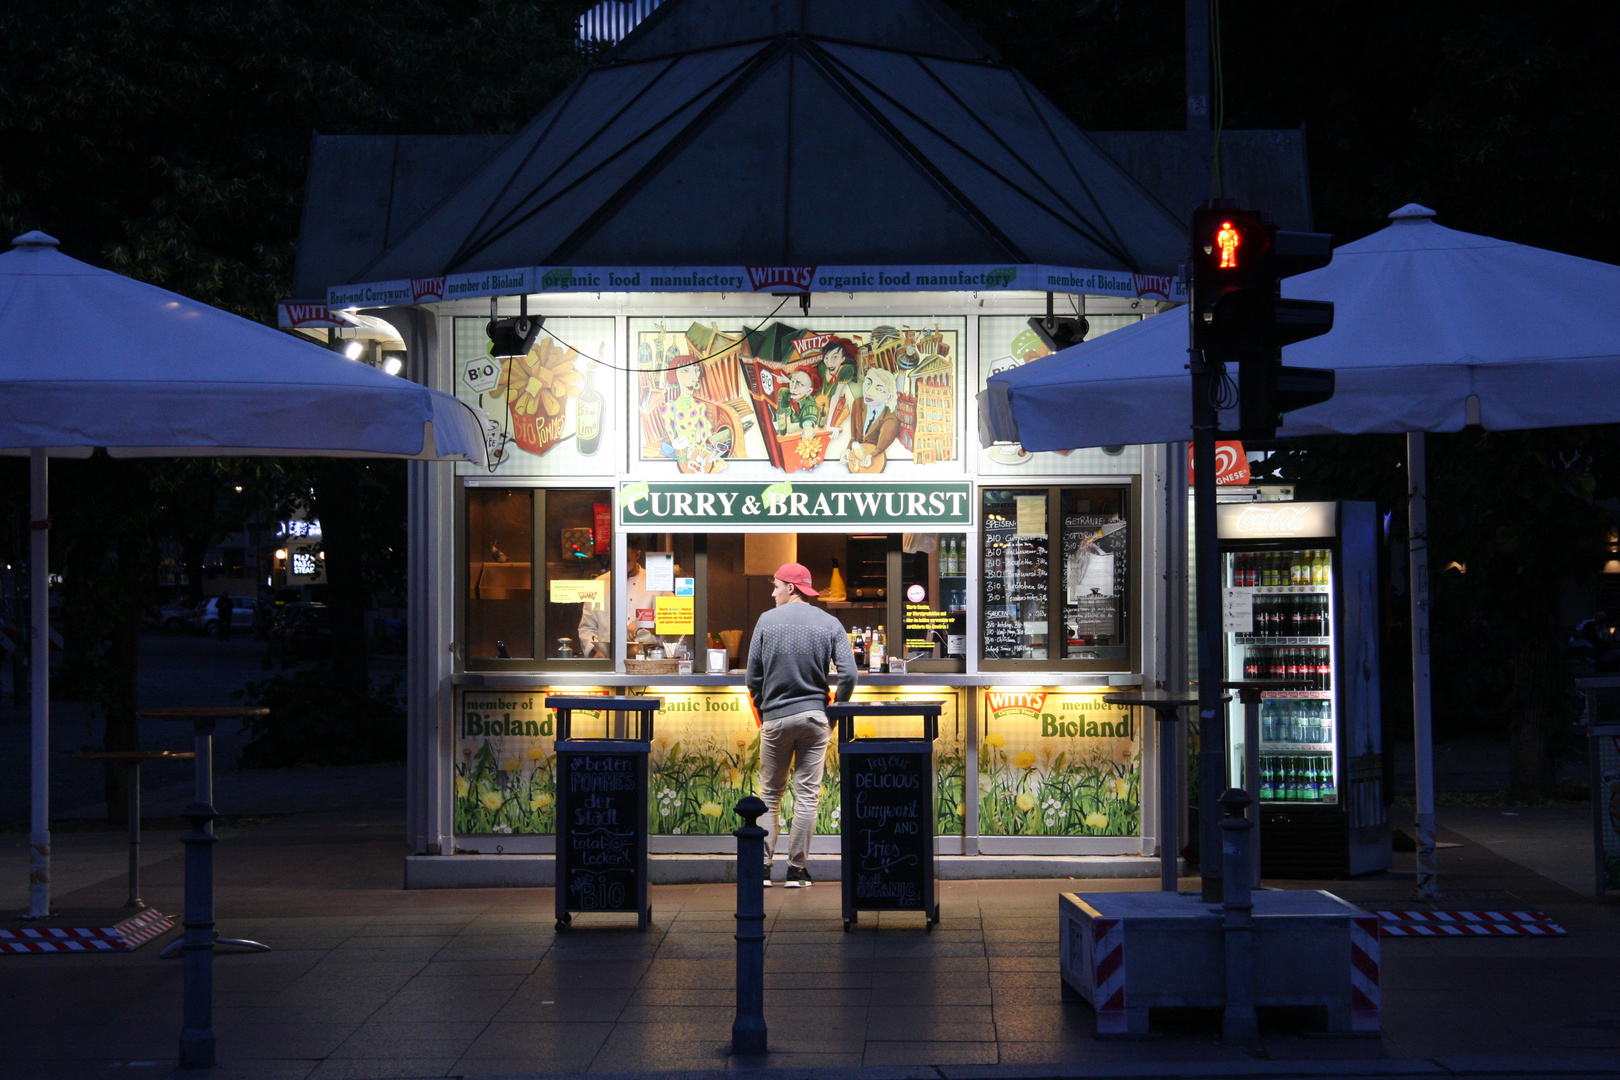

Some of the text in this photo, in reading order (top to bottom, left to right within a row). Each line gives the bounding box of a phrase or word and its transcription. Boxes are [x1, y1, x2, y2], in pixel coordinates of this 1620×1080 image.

[448, 273, 524, 294] member of Bioland
[544, 271, 744, 290] organic food manufactory
[819, 270, 1010, 288] organic food manufactory
[1048, 272, 1132, 291] member of Bioland
[365, 287, 410, 303] Currywurst
[627, 491, 967, 518] CURRY & BRATWURST
[1235, 506, 1310, 533] Coca-Cola
[467, 697, 533, 710] member of
[705, 696, 740, 712] food
[988, 692, 1044, 710] WITTY'S
[1062, 698, 1112, 711] member
[465, 711, 554, 737] Bioland
[1041, 713, 1129, 738] Bioland
[585, 756, 631, 772] besten
[866, 756, 887, 772] Try
[571, 772, 635, 792] POMMES
[856, 773, 920, 789] DELICIOUS
[584, 792, 614, 809] der
[856, 791, 919, 827] Currywurst
[574, 808, 619, 826] Stadt
[894, 821, 919, 835] AND
[572, 836, 605, 850] total
[859, 828, 900, 859] Fries
[857, 881, 916, 898] ORGANIC
